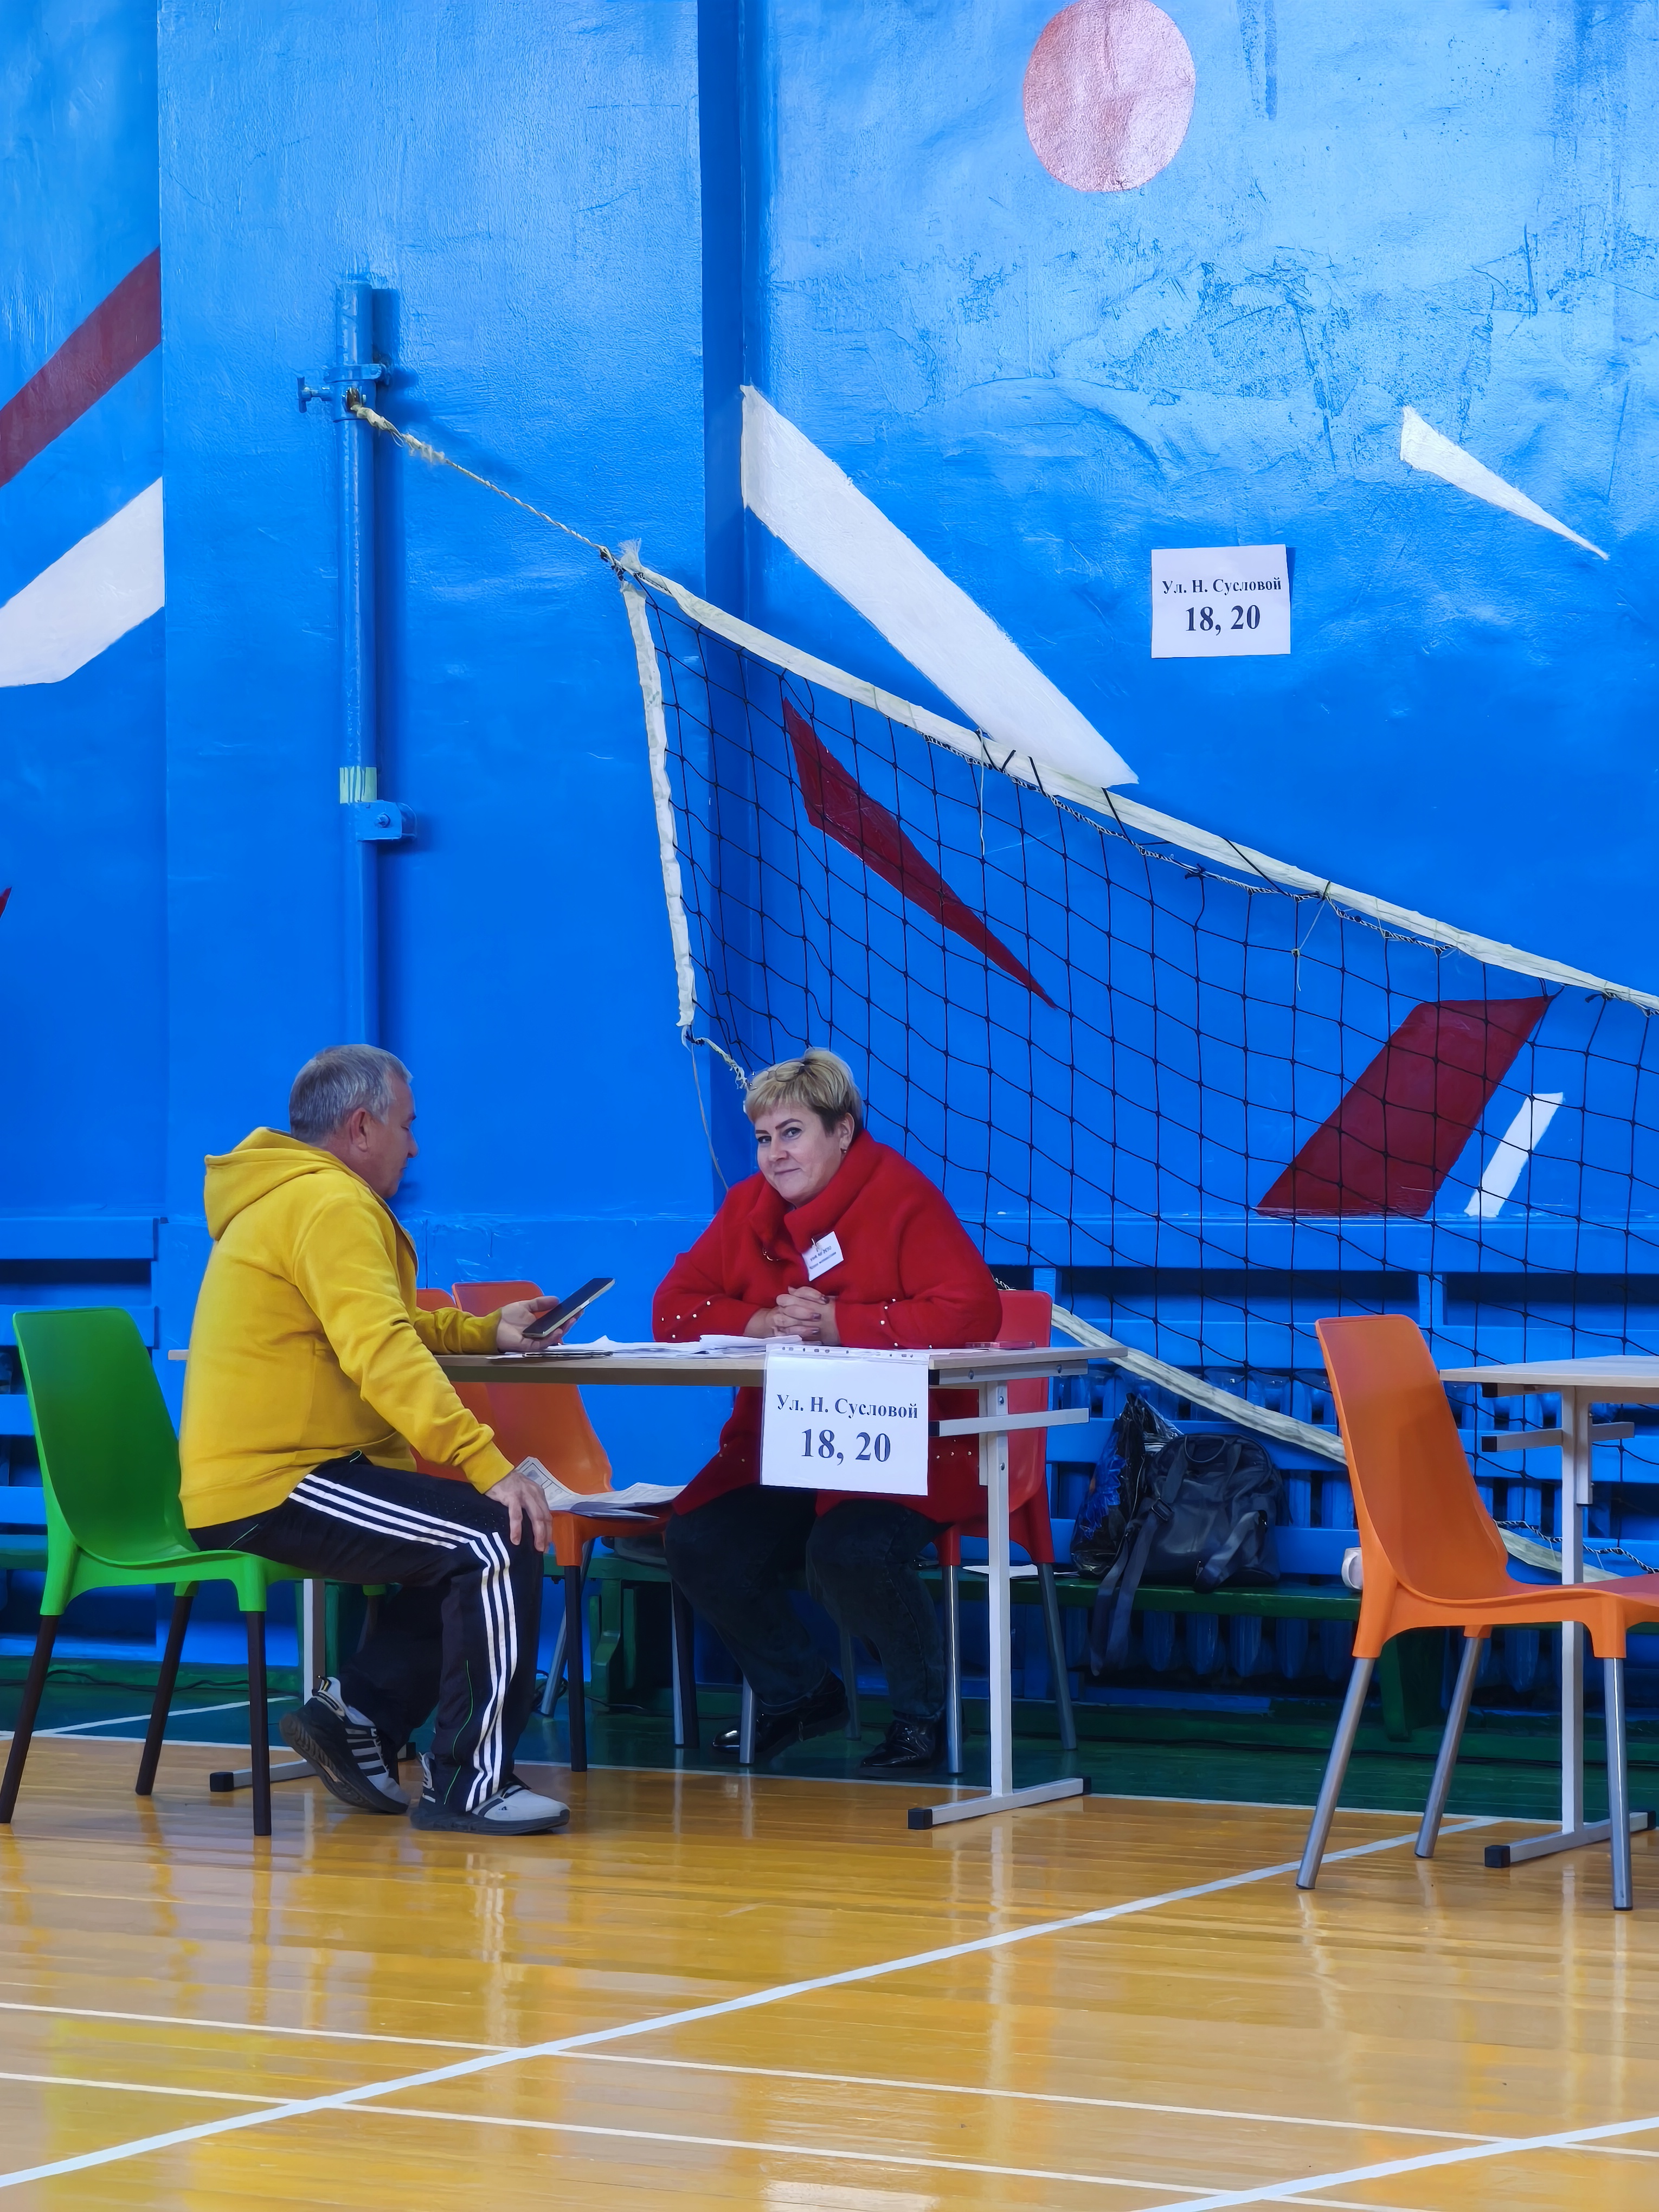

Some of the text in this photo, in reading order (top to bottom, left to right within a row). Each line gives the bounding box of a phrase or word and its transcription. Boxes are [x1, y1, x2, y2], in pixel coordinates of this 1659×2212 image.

[1162, 577, 1282, 596] Ул. Н. Сусловой
[1185, 605, 1261, 636] 18, 20
[776, 1394, 918, 1419] Ул. Н. Сусловой
[801, 1429, 891, 1466] 18, 20
